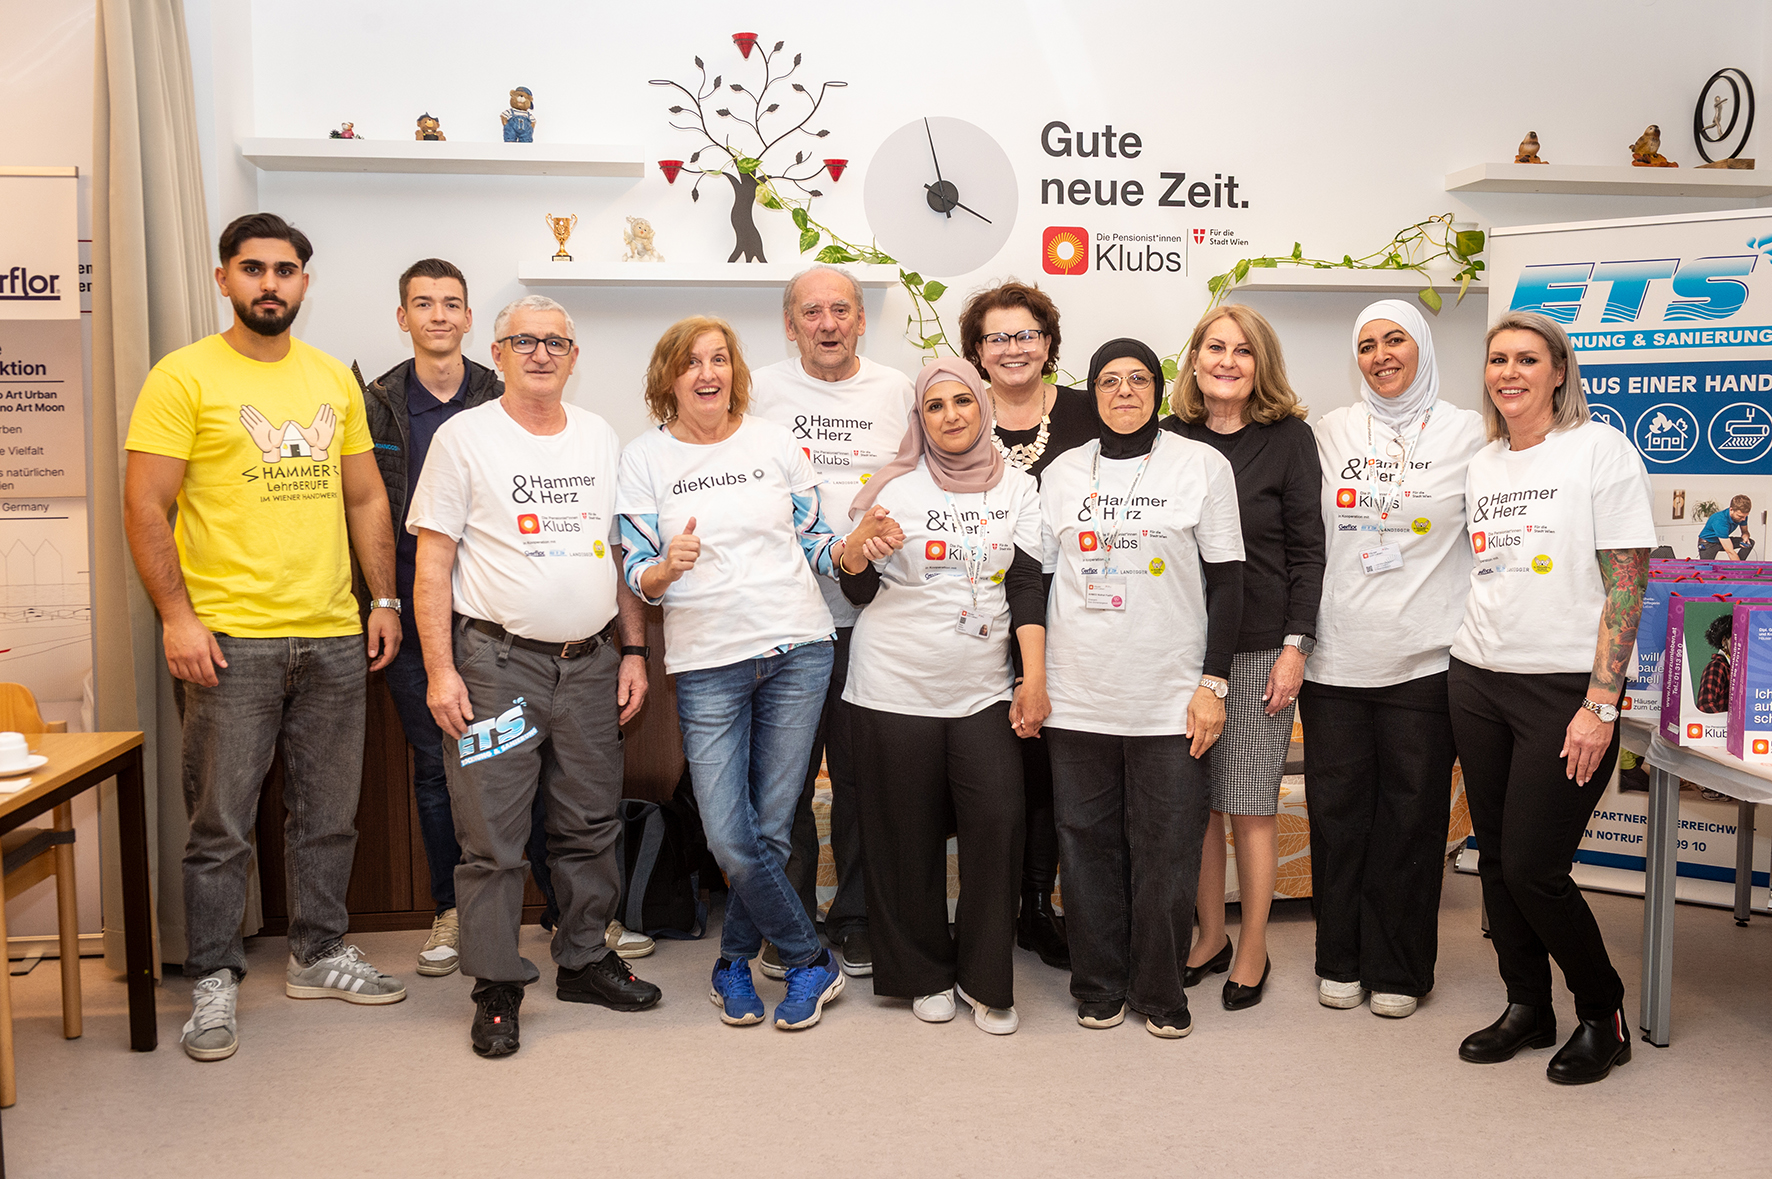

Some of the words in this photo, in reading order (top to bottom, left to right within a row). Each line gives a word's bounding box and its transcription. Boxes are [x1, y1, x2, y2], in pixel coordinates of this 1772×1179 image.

[1041, 121, 1143, 158] Gute
[1041, 178, 1144, 207] neue
[1158, 172, 1249, 209] Zeit.
[1096, 233, 1110, 241] Die
[1210, 238, 1228, 246] Stadt
[1230, 238, 1249, 246] Wien
[1096, 244, 1182, 272] Klubs
[1509, 255, 1759, 324] ETS
[1568, 334, 1626, 348] NUNG
[1632, 333, 1646, 346] &
[1653, 329, 1772, 346] SANIERUNG
[1580, 377, 1621, 394] AUS
[1628, 375, 1697, 393] EINER
[1705, 373, 1772, 392] HAND
[5, 390, 23, 399] Art
[24, 390, 57, 400] Urban
[15, 403, 33, 412] Art
[35, 403, 65, 412] Moon
[811, 415, 873, 430] Hammer
[817, 428, 852, 441] Herz
[8, 446, 44, 455] Vielfalt
[813, 453, 850, 466] Klubs
[6, 468, 65, 477] natürlichen
[263, 464, 330, 479] HAMMER
[1341, 458, 1362, 480] &
[267, 480, 329, 492] LehrBERUFE
[512, 475, 537, 504] &
[530, 475, 595, 489] Hammer
[672, 472, 747, 495] dieKlubs
[272, 494, 300, 502] WIENER
[540, 491, 579, 504] Herz
[1359, 495, 1400, 509] Kls
[2, 502, 49, 513] Germany
[1473, 496, 1489, 523] &
[1490, 488, 1558, 506] Hammer
[1492, 505, 1527, 519] Herz
[926, 510, 948, 531] &
[1103, 507, 1141, 520] Hrz
[542, 520, 581, 532] Klubs
[952, 523, 990, 535] Her
[1101, 537, 1138, 549] ubs
[1488, 535, 1521, 549] Klubs
[949, 548, 987, 561] Kls
[1641, 652, 1660, 661] will
[458, 705, 525, 758] ETS
[1593, 810, 1647, 824] PARTNER
[1582, 829, 1592, 838] N
[1597, 830, 1643, 844] NOTRUF
[1692, 842, 1707, 852] 10
